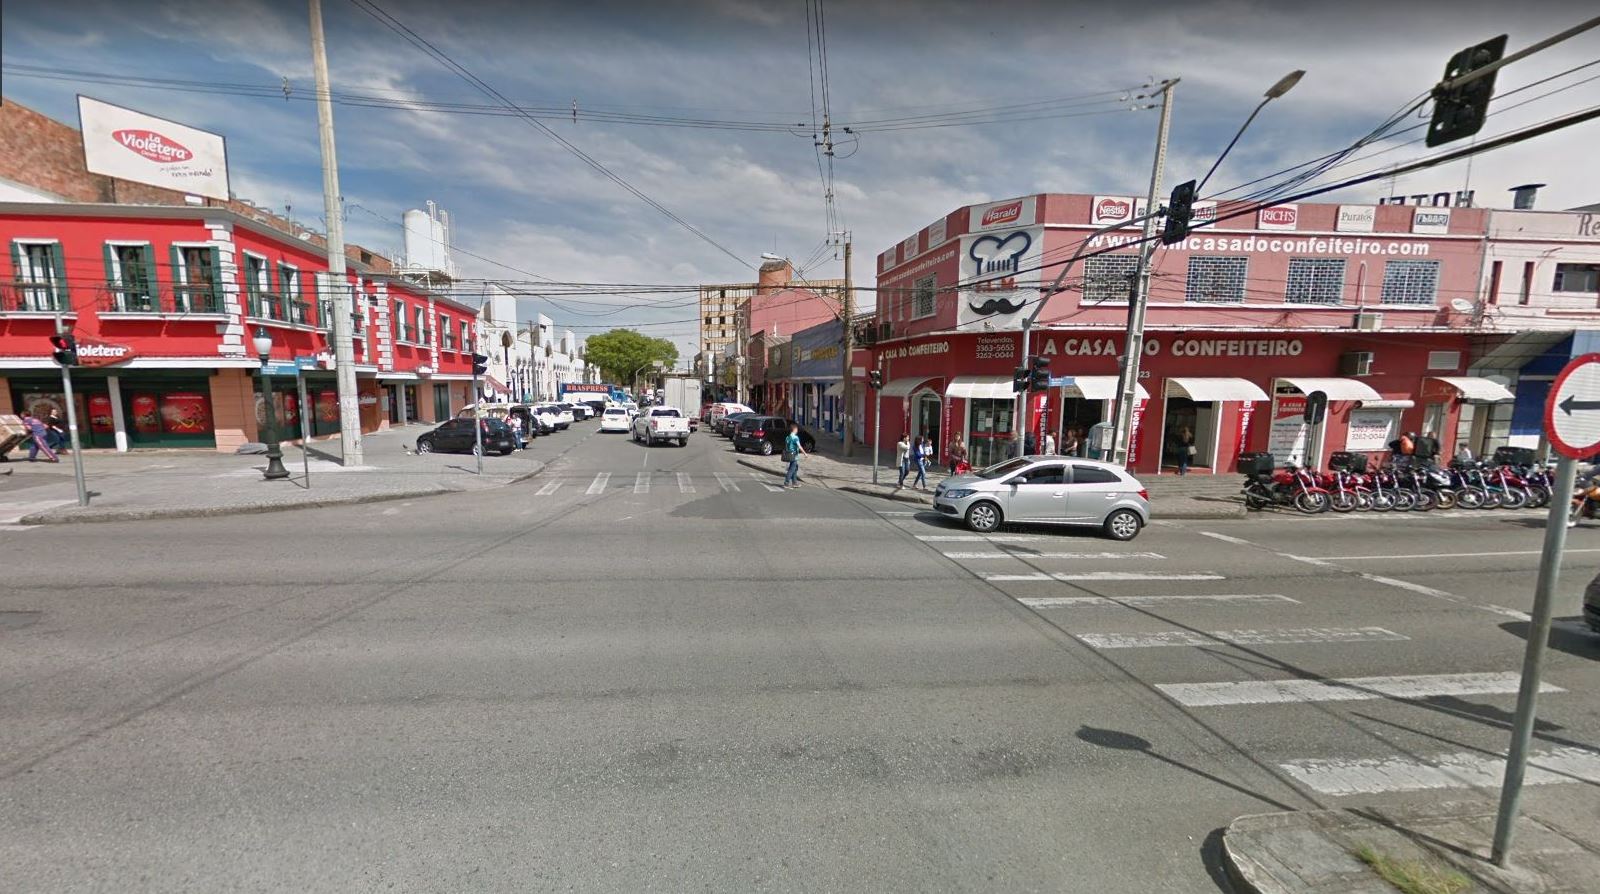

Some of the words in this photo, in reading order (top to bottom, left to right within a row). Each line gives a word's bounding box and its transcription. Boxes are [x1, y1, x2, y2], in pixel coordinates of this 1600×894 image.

[149, 133, 160, 143] La
[121, 132, 186, 160] Violetera
[987, 207, 1018, 219] Harald
[1341, 211, 1373, 222] Puratos
[75, 344, 125, 357] ioletera
[885, 350, 897, 359] CASA
[899, 348, 907, 357] DO
[908, 341, 949, 356] CONFEITEIRO
[1043, 339, 1057, 355] A
[1064, 339, 1117, 356] CASA
[1171, 339, 1303, 356] CONFEITEIRO
[975, 351, 1014, 359] 3262-0044
[566, 384, 609, 392] BRASPRESS
